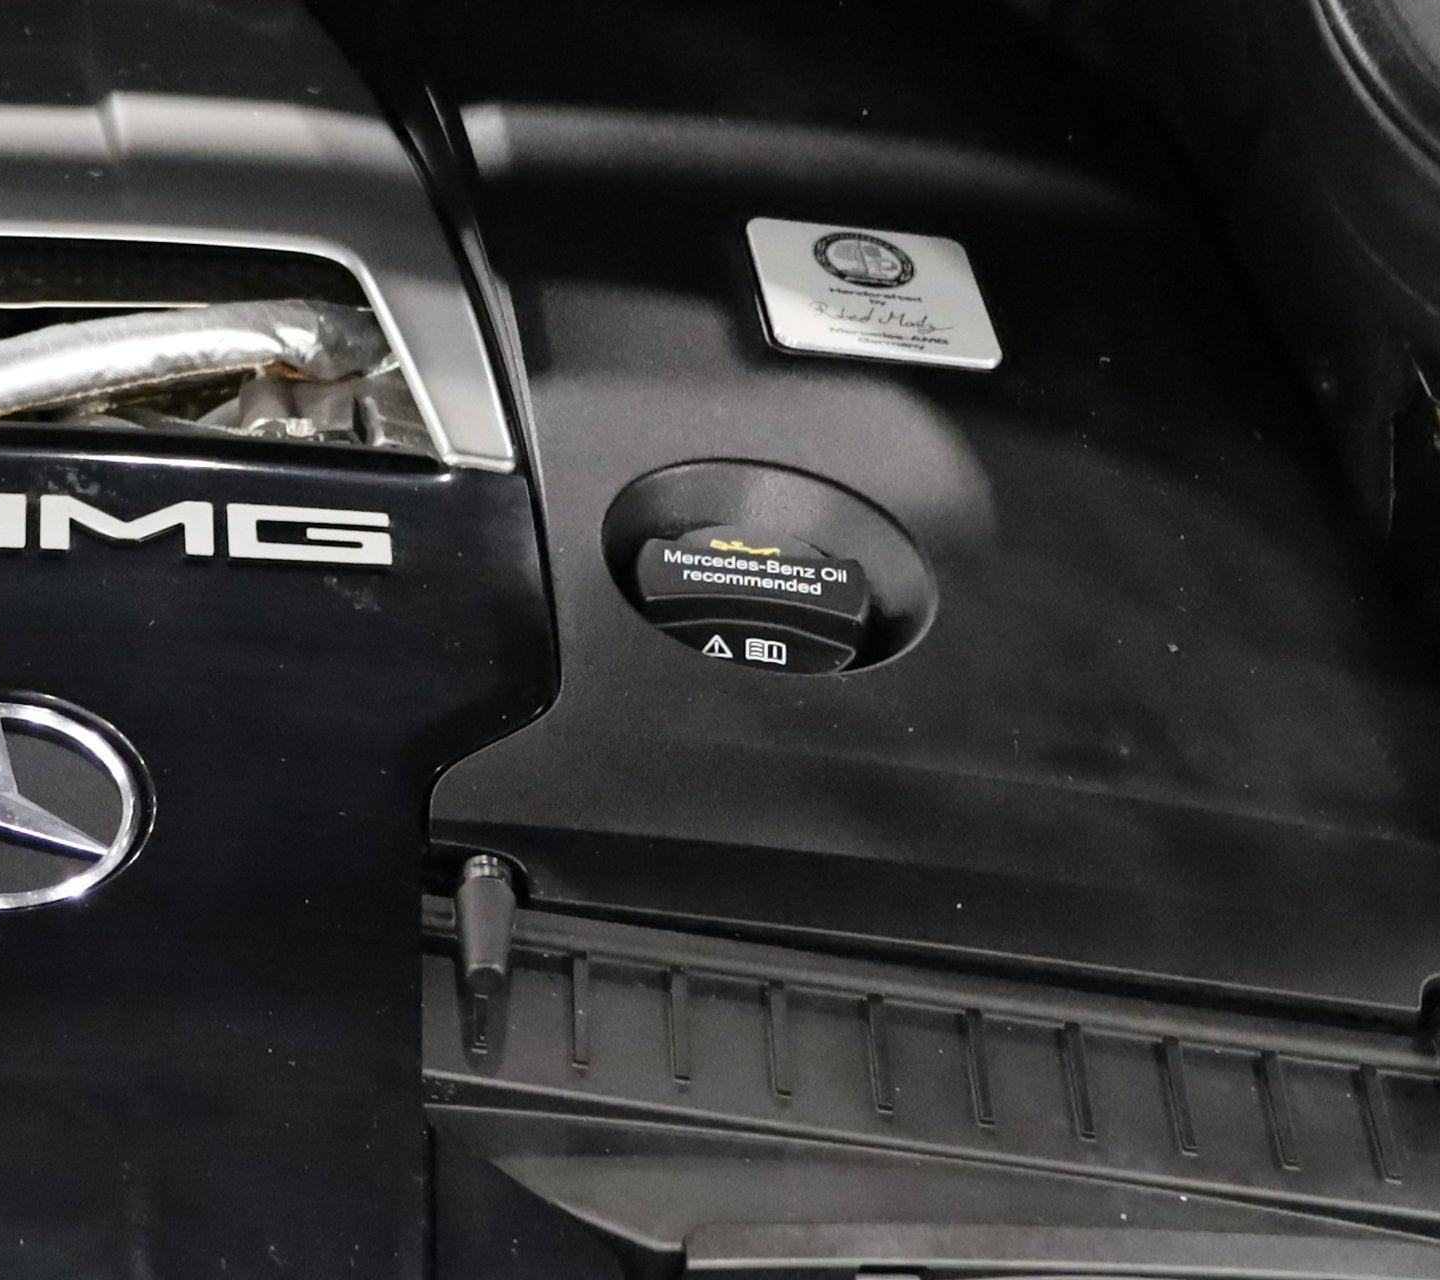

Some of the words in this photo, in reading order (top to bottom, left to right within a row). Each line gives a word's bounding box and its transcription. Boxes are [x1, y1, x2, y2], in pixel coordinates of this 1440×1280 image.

[663, 548, 817, 580] Mercedes-Benz
[820, 565, 848, 584] Oil
[682, 567, 823, 596] recommended
